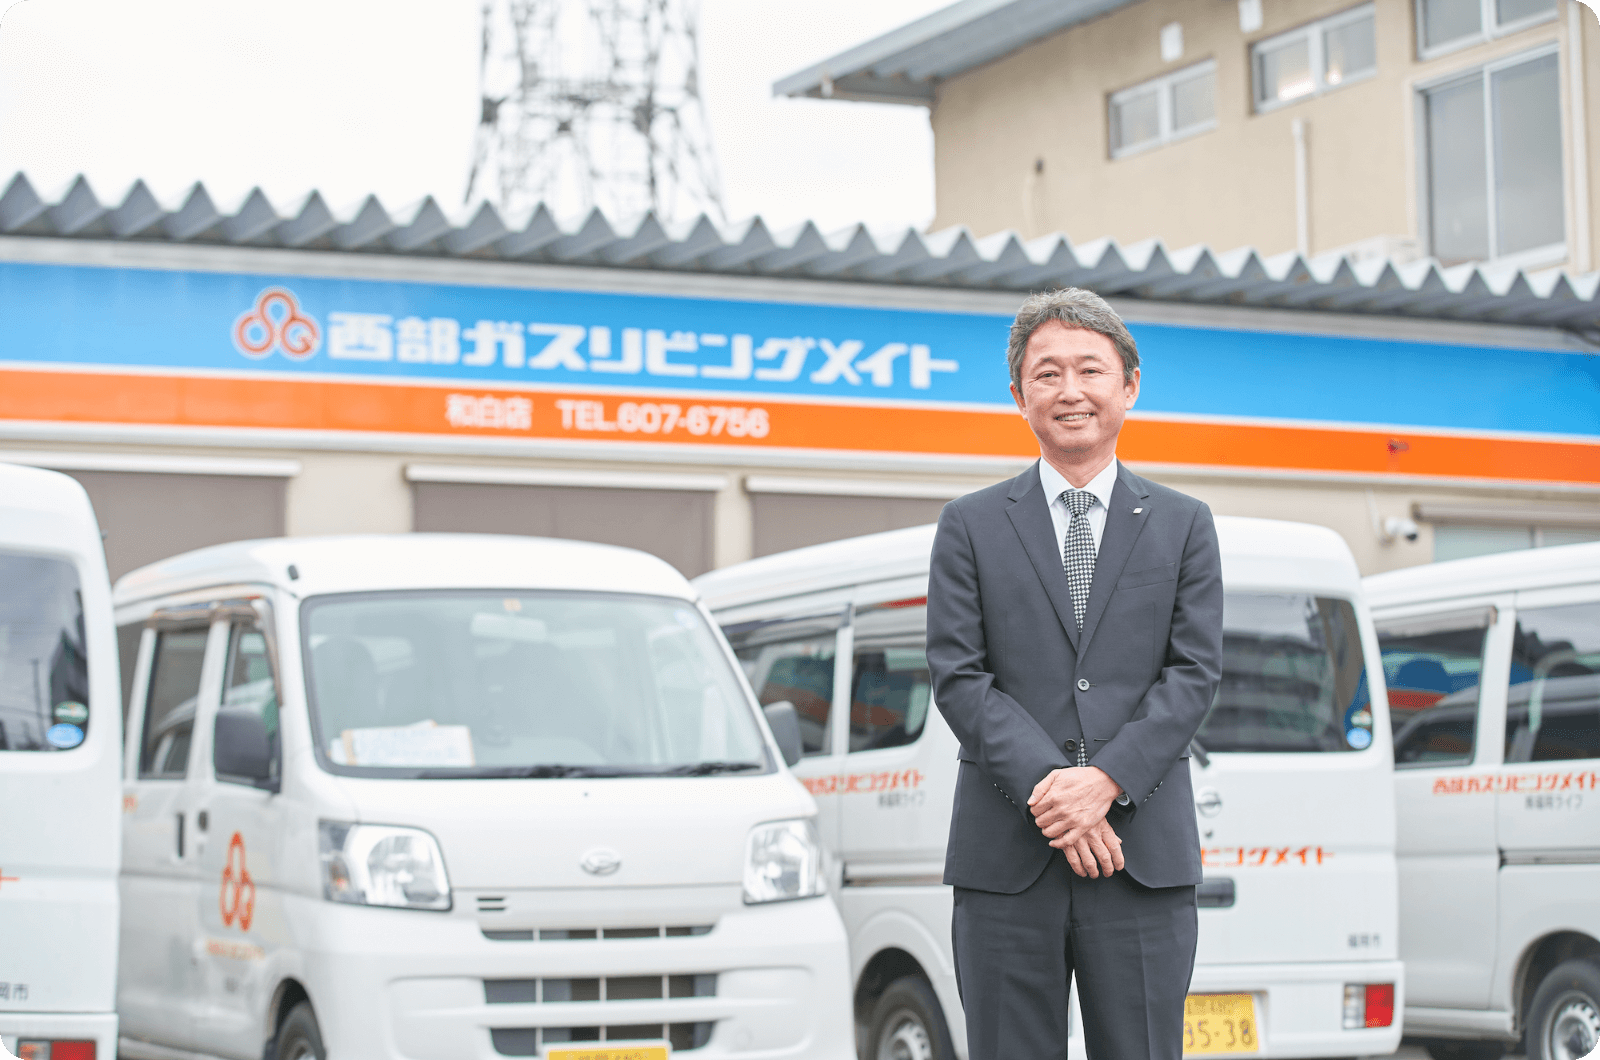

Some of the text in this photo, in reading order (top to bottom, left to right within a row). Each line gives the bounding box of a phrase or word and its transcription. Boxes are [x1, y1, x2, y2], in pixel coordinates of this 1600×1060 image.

[327, 311, 960, 389] 西部ガスリビングメイト
[445, 394, 771, 438] 和白店 TEL.607-6756
